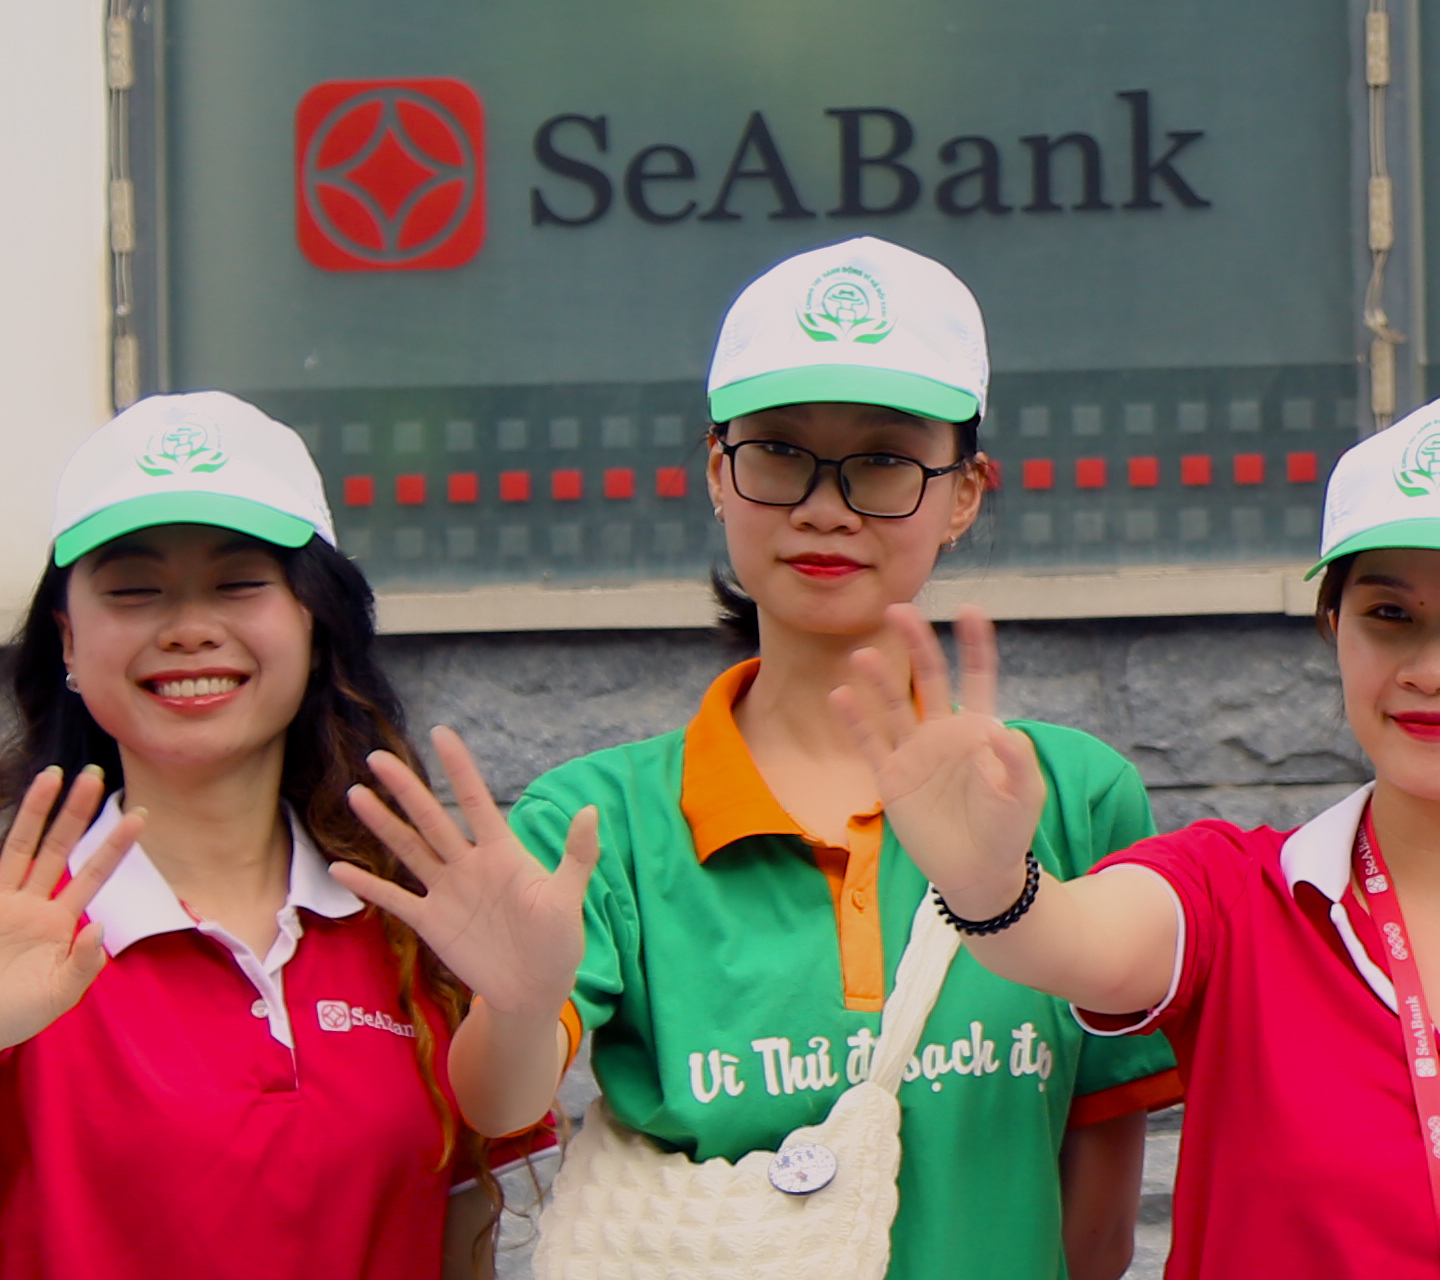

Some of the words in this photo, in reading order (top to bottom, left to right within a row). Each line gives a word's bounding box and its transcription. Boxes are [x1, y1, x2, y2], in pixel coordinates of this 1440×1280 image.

[529, 90, 1211, 228] SeABank
[351, 1005, 419, 1039] SeABan
[1405, 995, 1430, 1056] SeABank
[752, 1035, 838, 1097] Thủ
